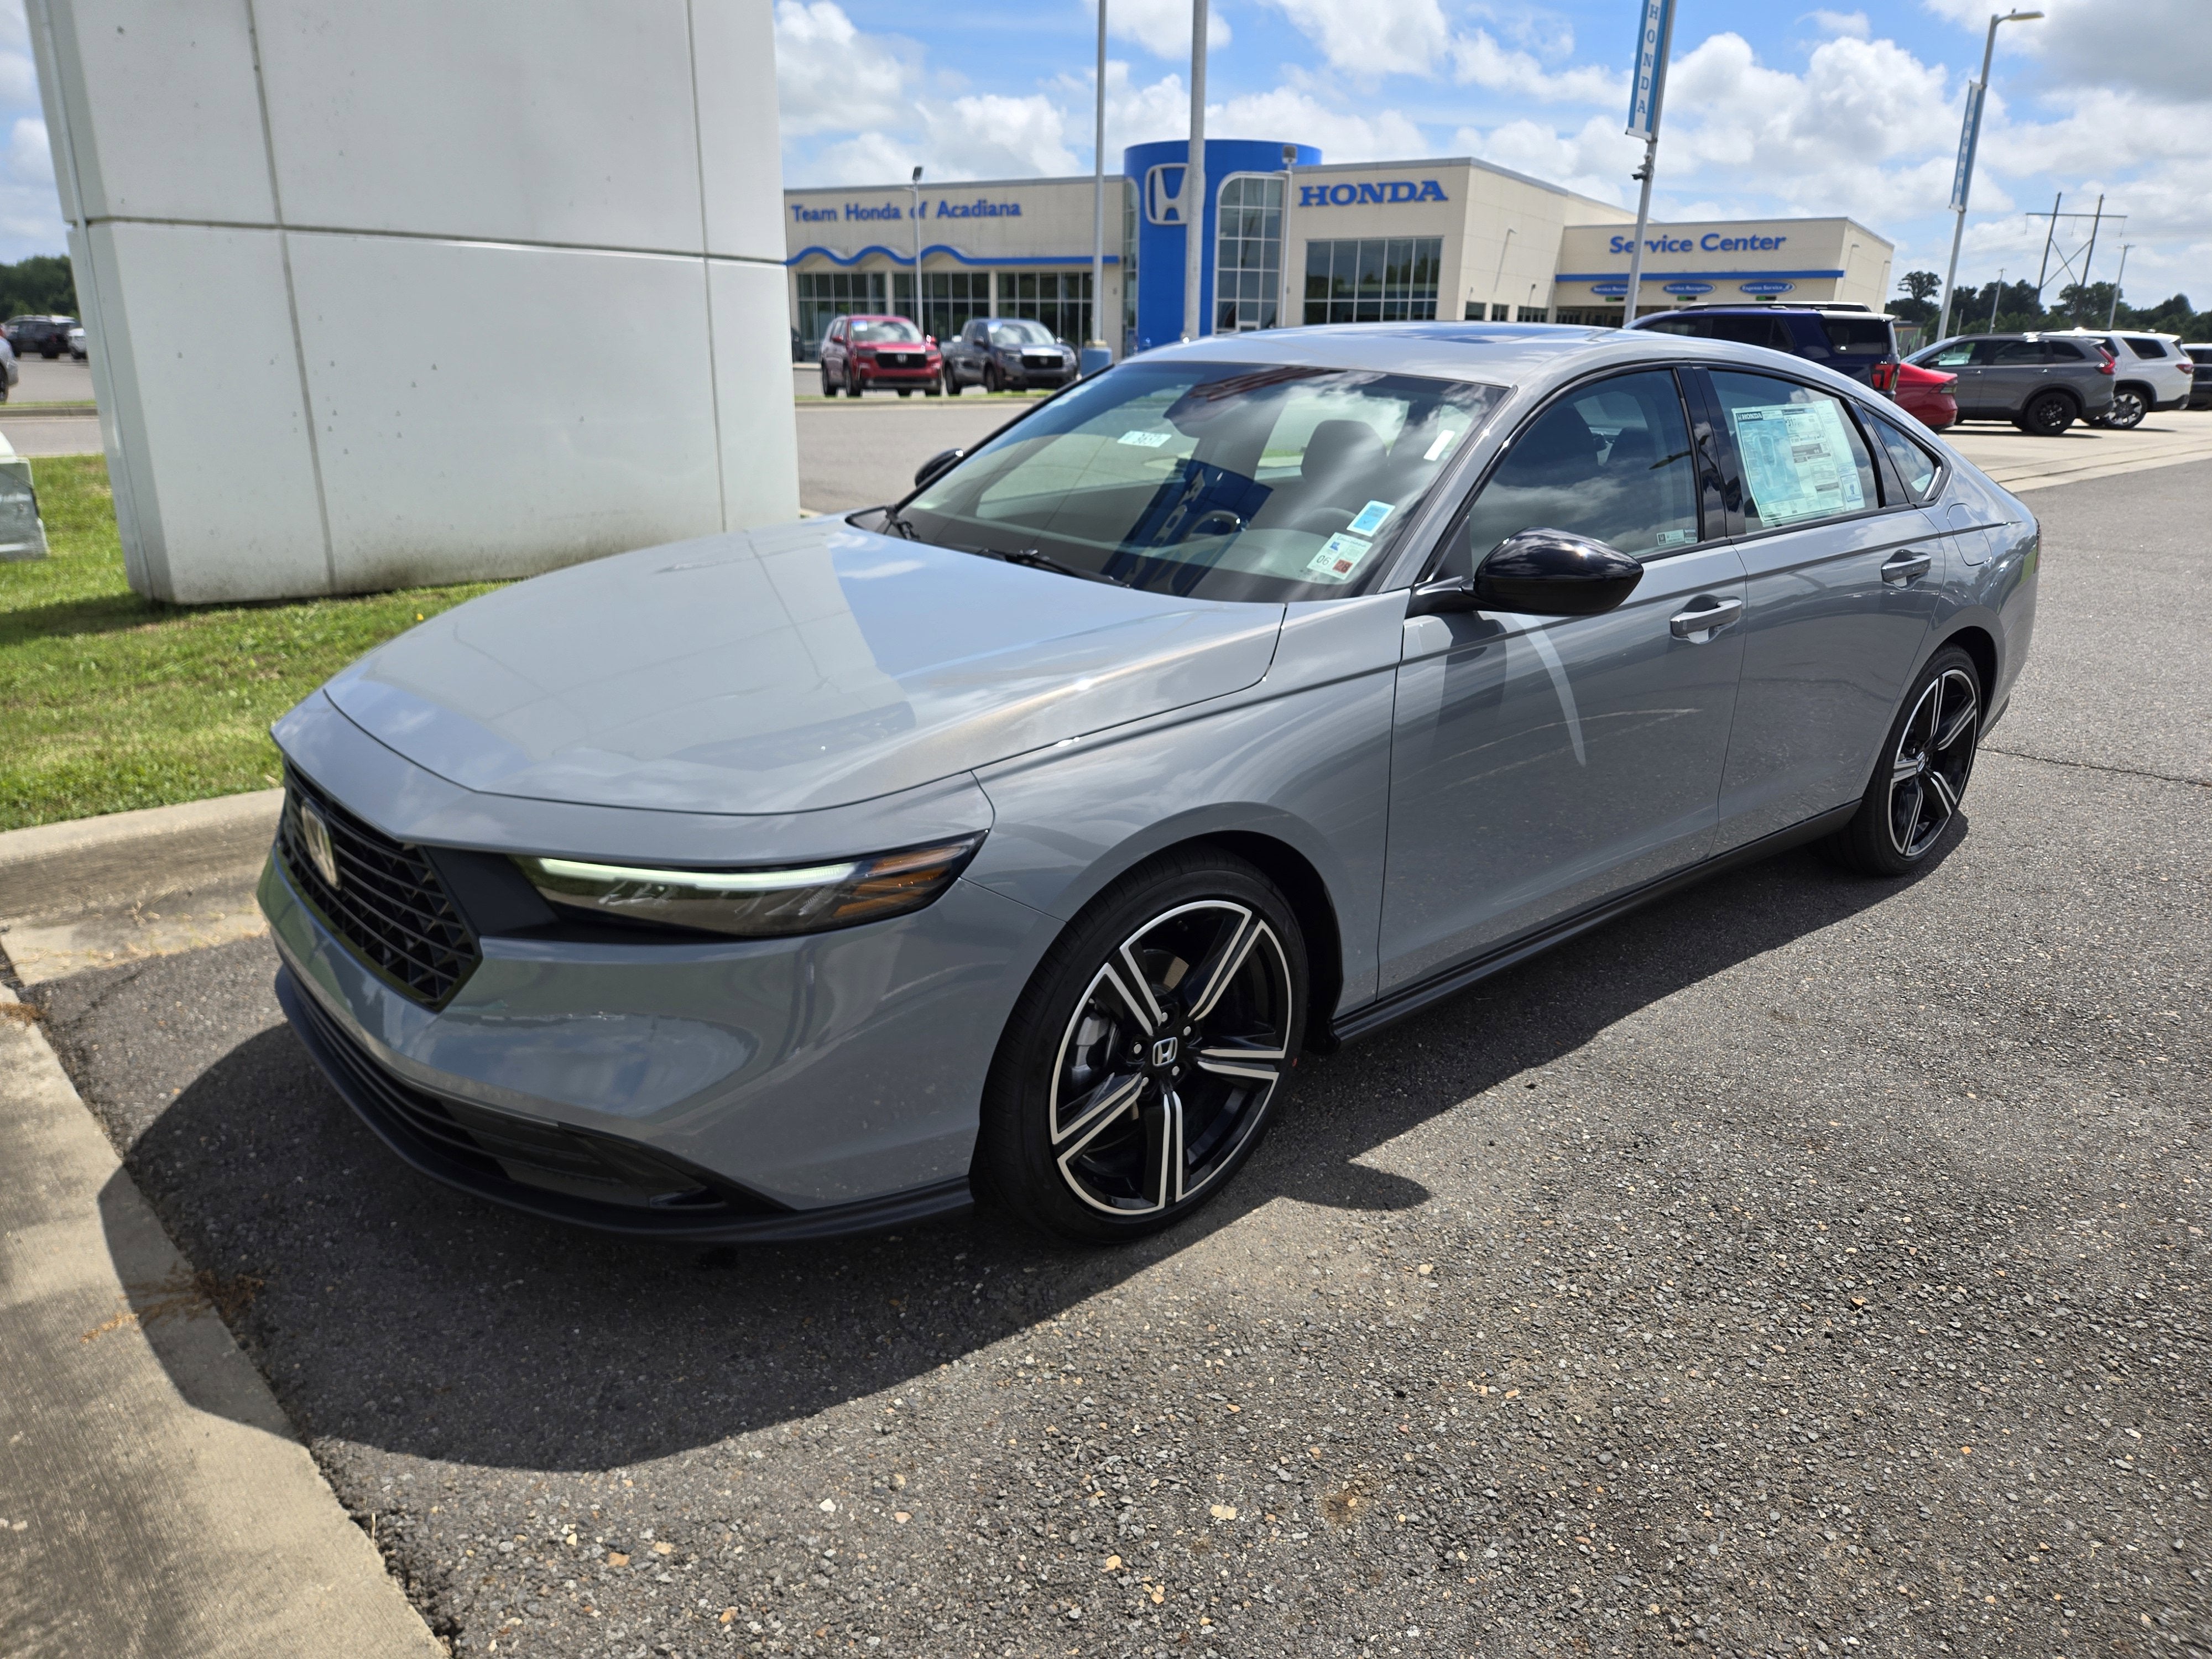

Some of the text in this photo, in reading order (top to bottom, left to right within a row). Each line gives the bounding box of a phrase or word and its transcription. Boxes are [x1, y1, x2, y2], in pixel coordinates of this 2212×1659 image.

[1637, 4, 1659, 114] HONDA
[1298, 180, 1449, 207] HONDA
[791, 204, 837, 221] Team
[845, 202, 902, 220] Honda
[936, 199, 1022, 218] Acadiana
[1700, 233, 1787, 252] Center
[1316, 555, 1332, 565] 06
